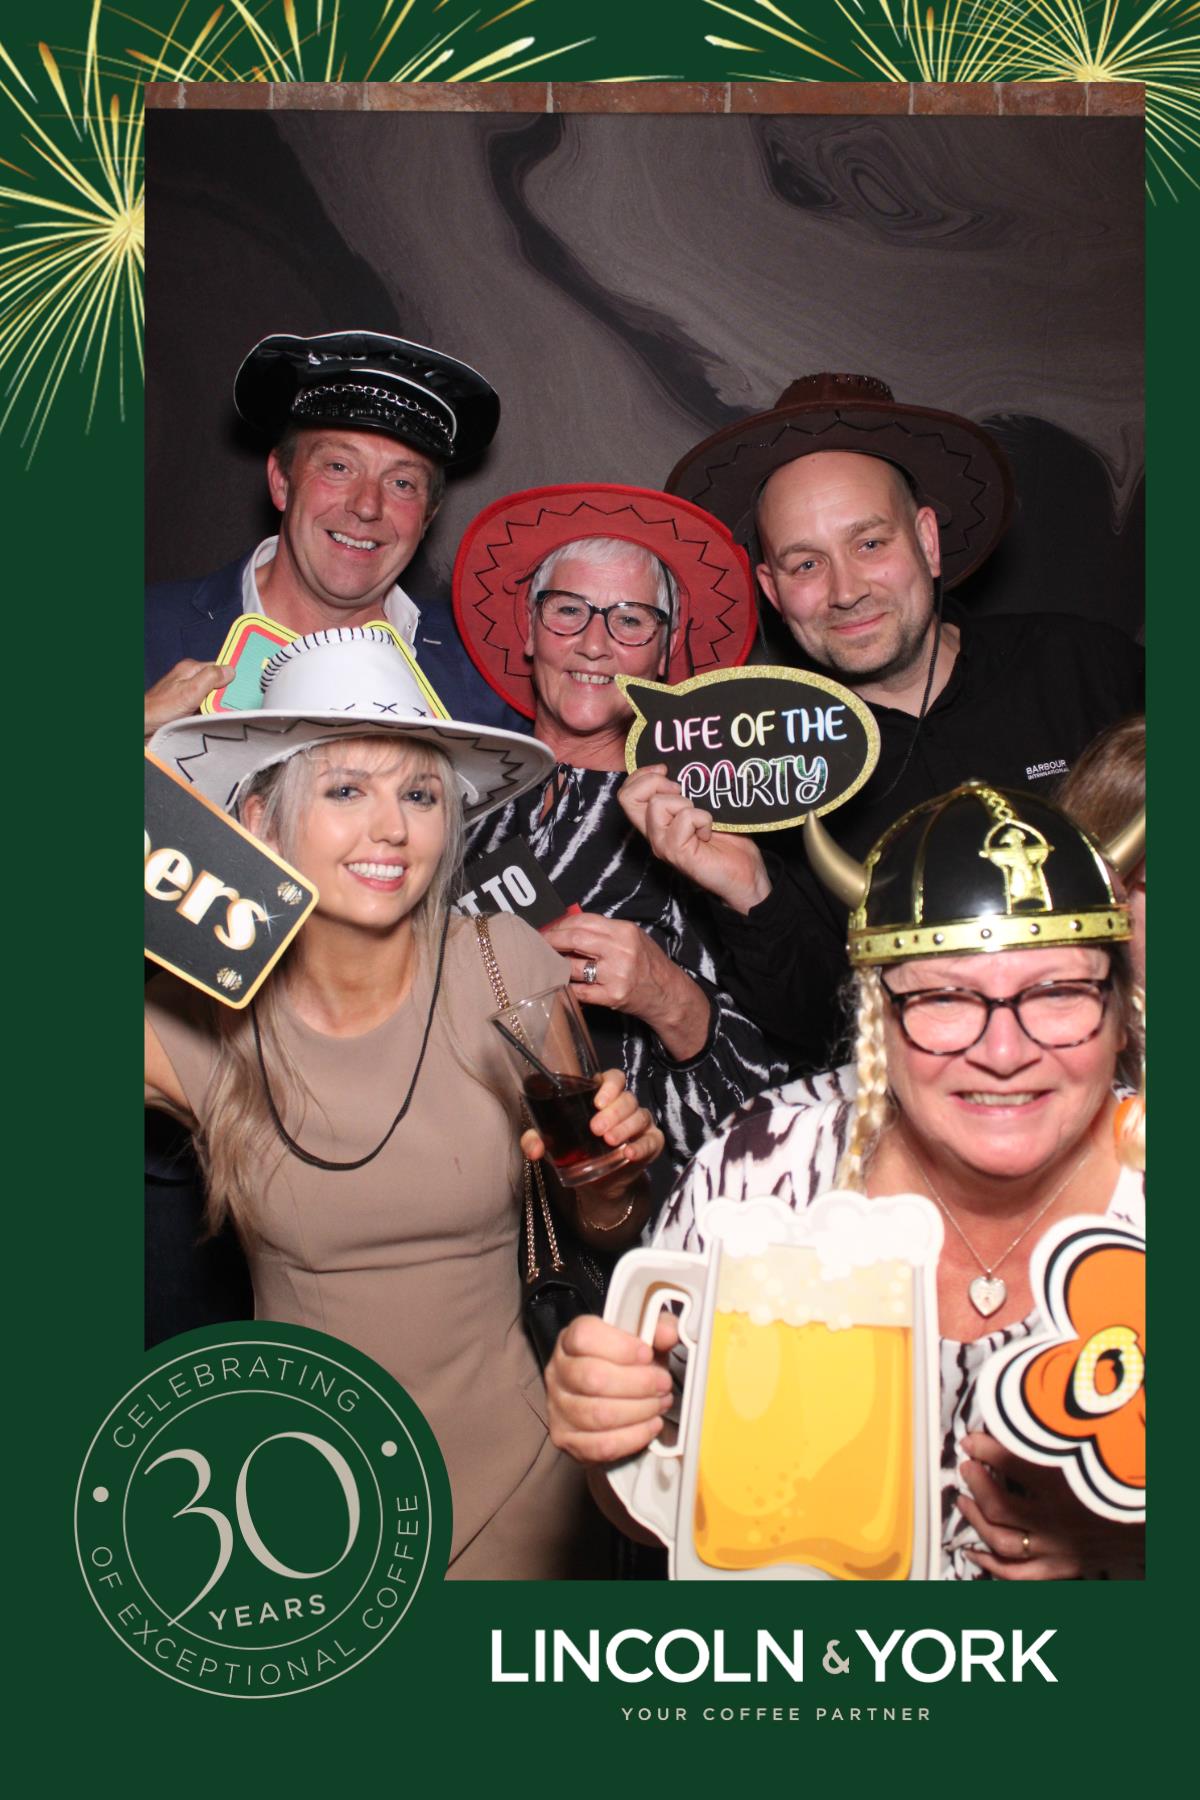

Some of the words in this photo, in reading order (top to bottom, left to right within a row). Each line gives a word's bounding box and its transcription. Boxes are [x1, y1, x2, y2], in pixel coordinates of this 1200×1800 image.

[654, 715, 723, 752] LIFE
[730, 710, 776, 747] OF
[781, 705, 848, 743] THE
[677, 755, 828, 808] PARTY
[1025, 759, 1067, 775] BARBOUR
[144, 829, 268, 951] ers
[480, 865, 537, 915] TO
